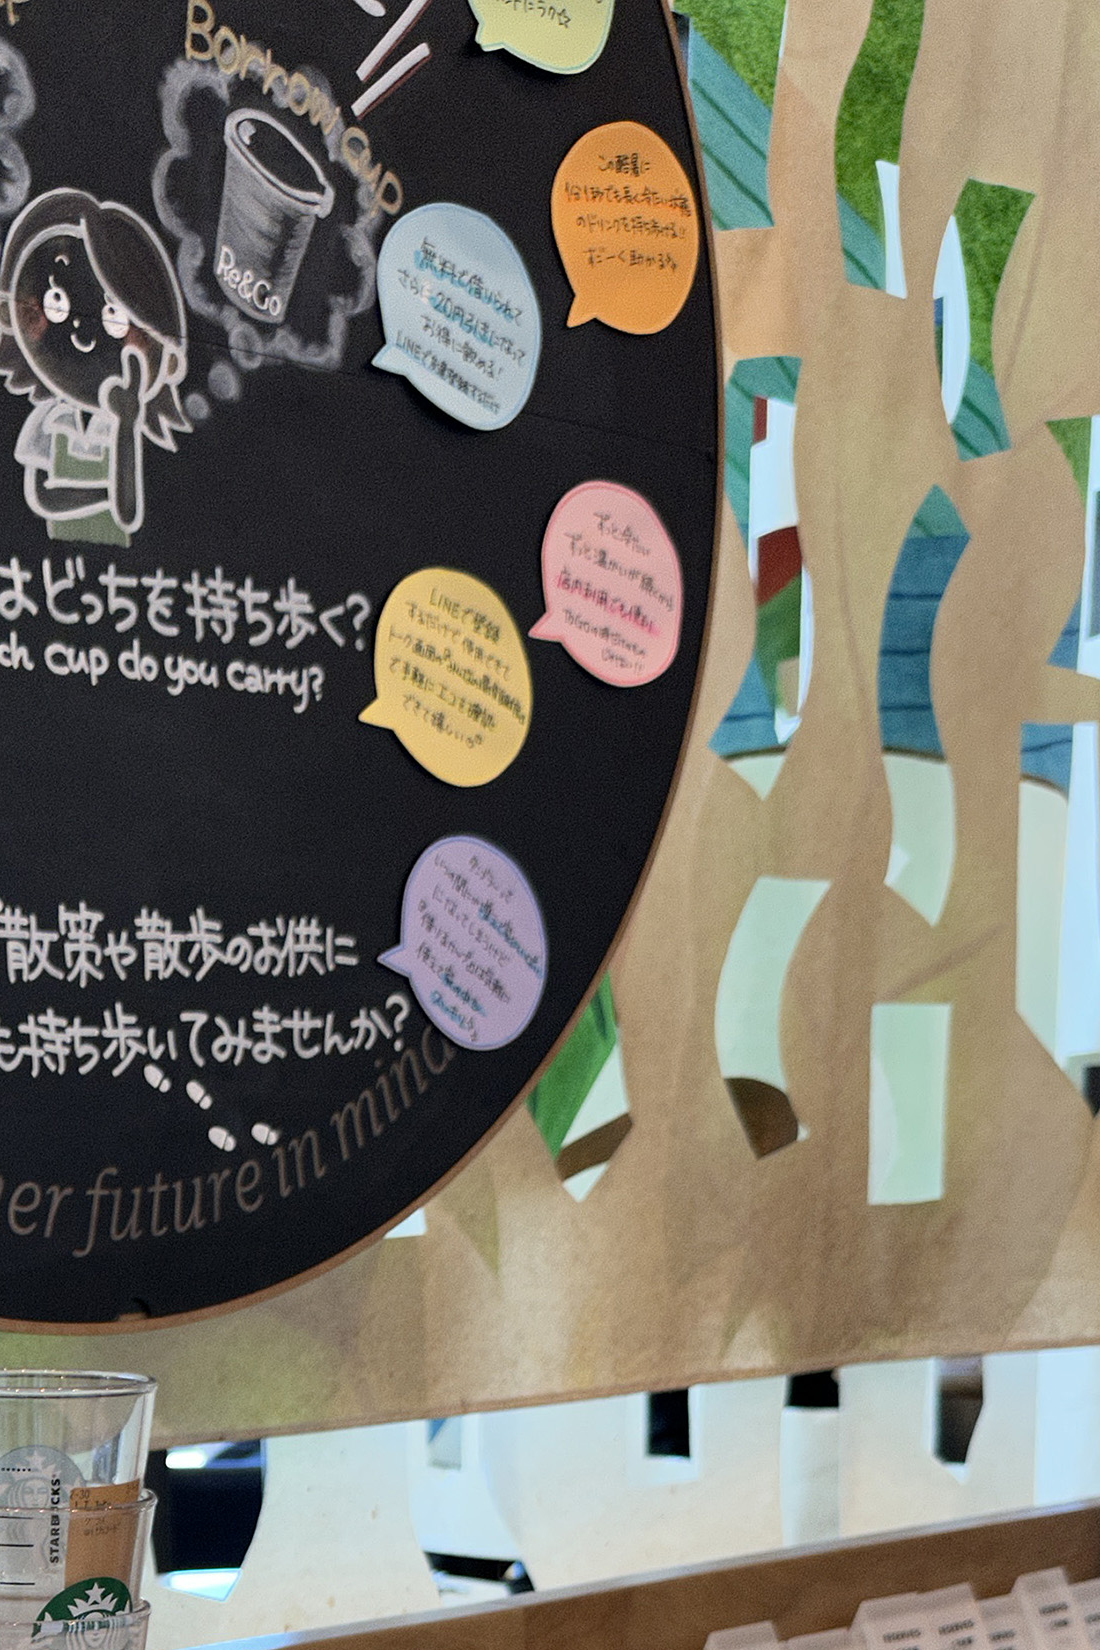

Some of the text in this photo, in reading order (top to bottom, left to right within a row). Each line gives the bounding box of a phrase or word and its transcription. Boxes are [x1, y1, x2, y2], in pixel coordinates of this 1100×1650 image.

[216, 244, 282, 317] Re&Go
[45, 642, 109, 686] cup
[118, 639, 158, 681] do
[164, 655, 218, 696] you
[226, 661, 326, 714] carry?
[71, 1152, 267, 1258] future
[269, 1128, 326, 1199] in
